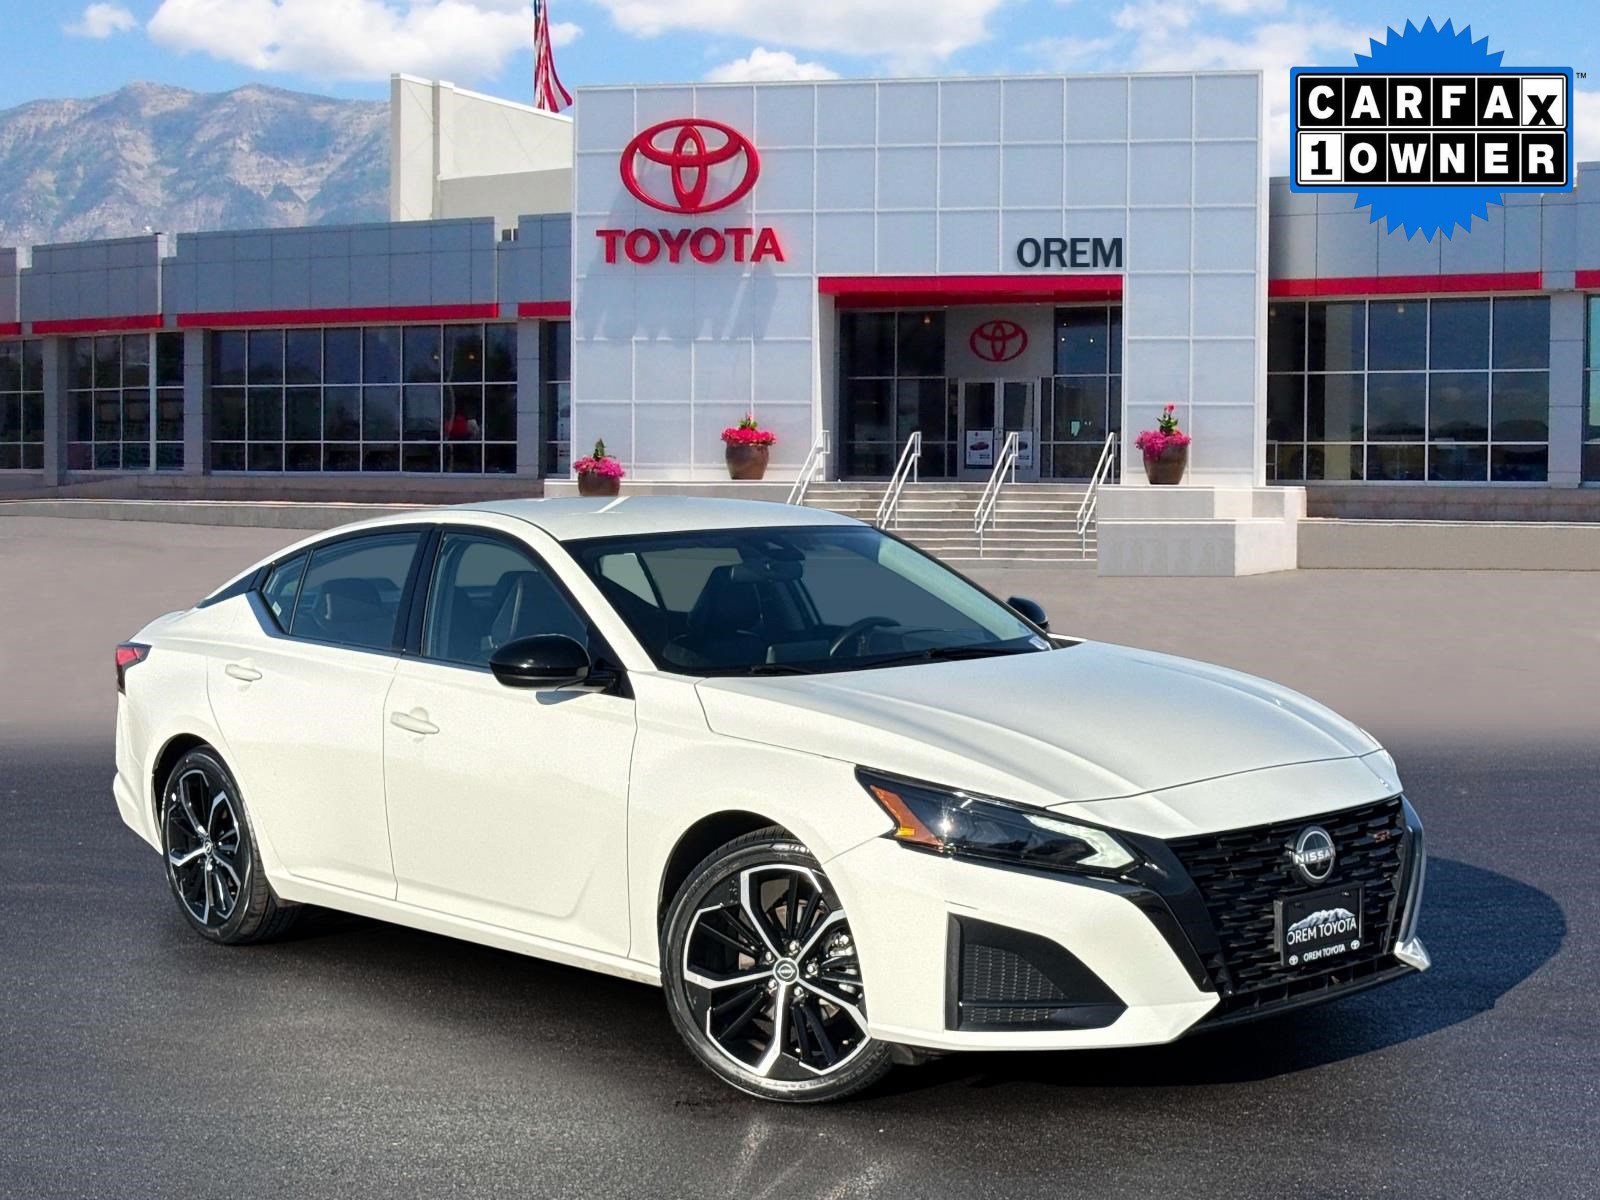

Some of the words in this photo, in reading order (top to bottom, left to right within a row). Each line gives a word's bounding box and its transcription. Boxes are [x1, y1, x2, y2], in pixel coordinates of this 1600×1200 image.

[596, 227, 784, 264] TOYOTA
[1017, 238, 1122, 267] OREM
[1287, 926, 1317, 945] OREM
[1318, 917, 1357, 938] TOYOTA
[1303, 949, 1322, 962] OREM
[1322, 943, 1346, 957] TOYOTA
